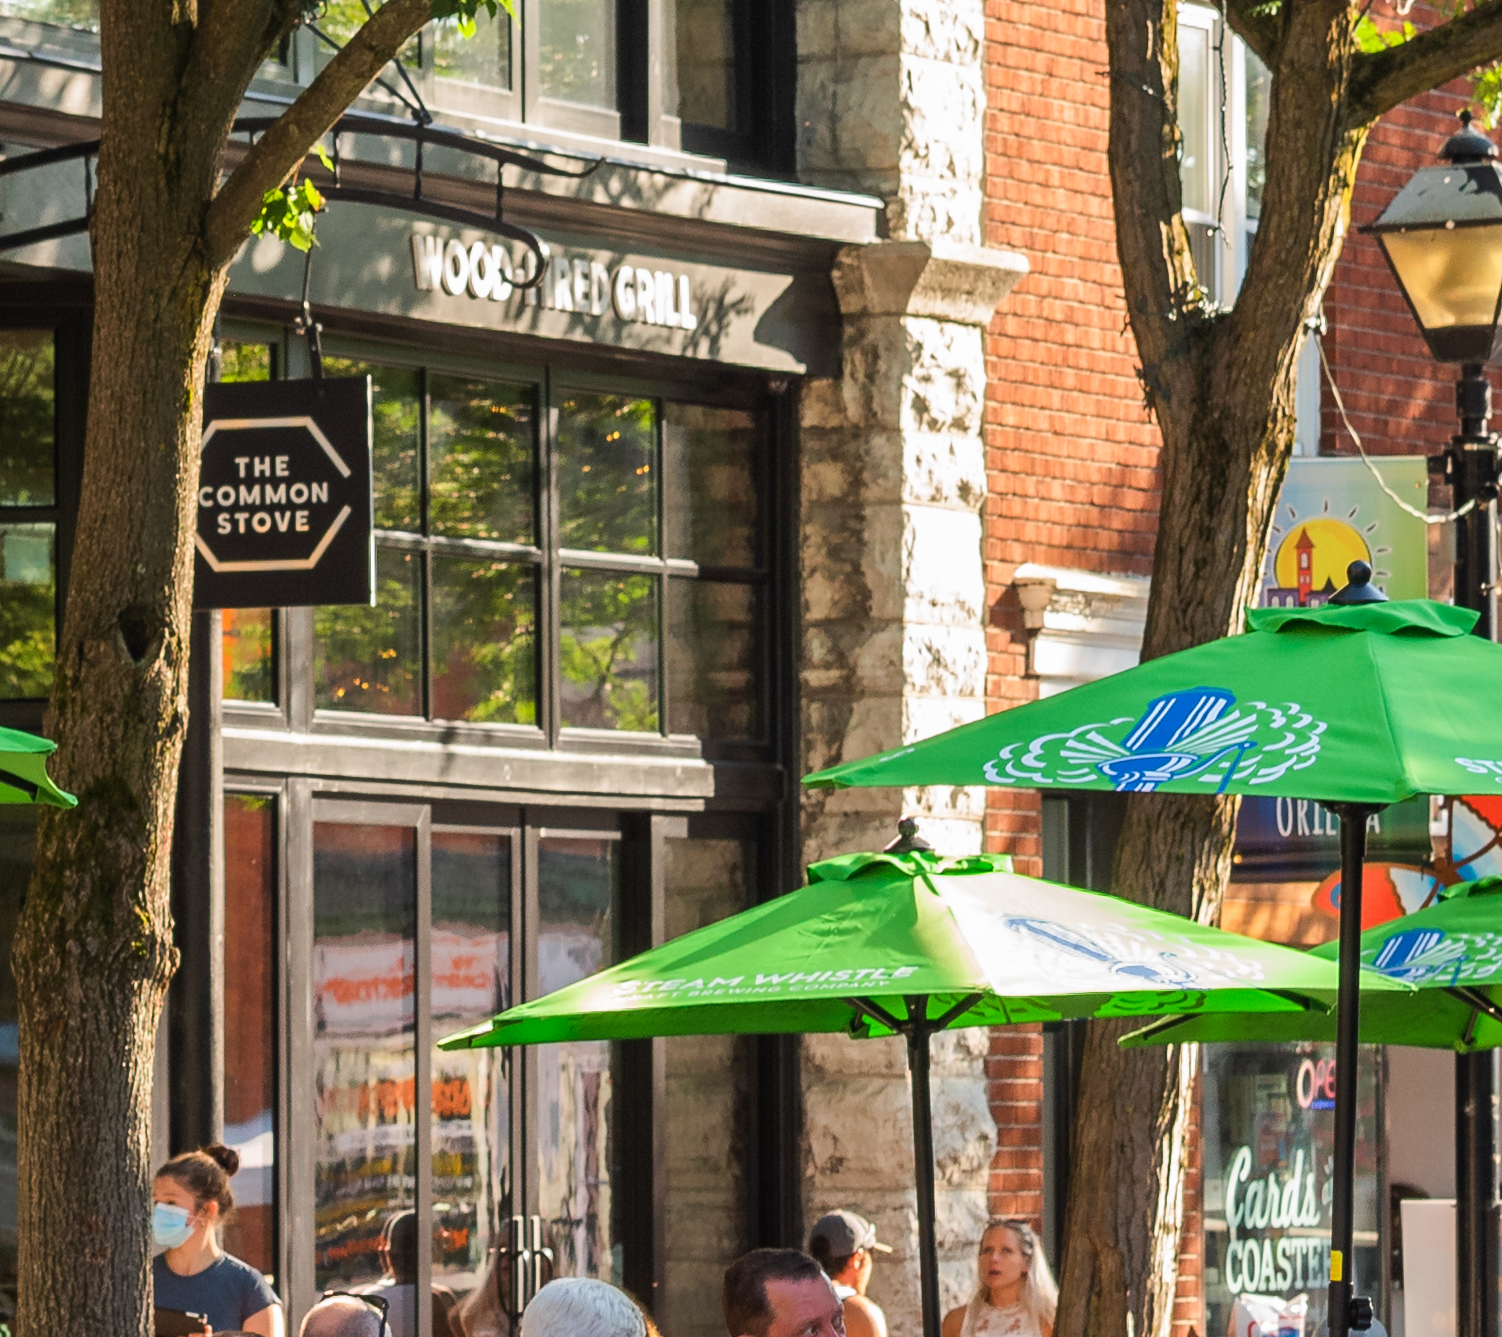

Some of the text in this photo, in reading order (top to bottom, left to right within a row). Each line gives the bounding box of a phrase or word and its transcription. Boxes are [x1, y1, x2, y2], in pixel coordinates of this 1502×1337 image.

[613, 264, 698, 330] GRILL
[234, 455, 290, 478] THE
[198, 481, 329, 507] COMMON
[217, 509, 311, 535] STOVE
[613, 966, 919, 996] STEAM WHISTLE
[687, 985, 781, 997] BREWING
[787, 979, 891, 993] COMPANY
[1225, 1145, 1321, 1230] Cards
